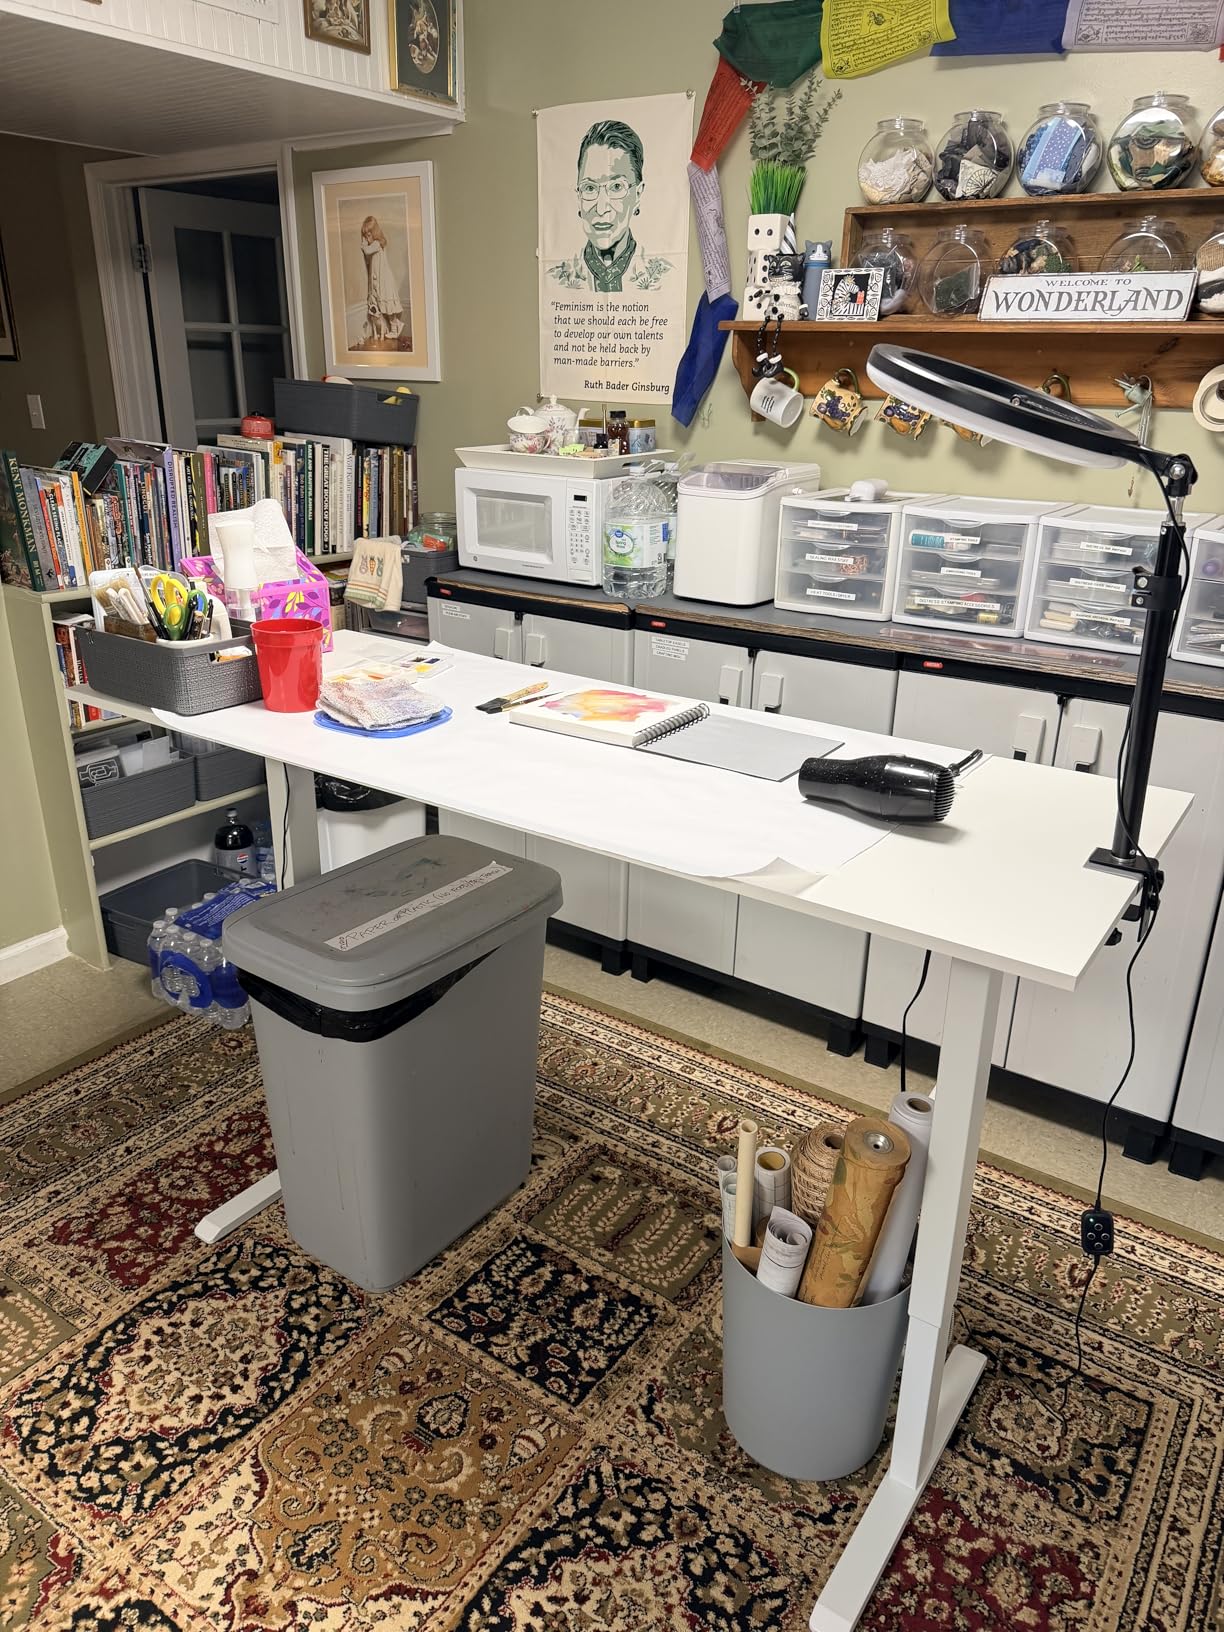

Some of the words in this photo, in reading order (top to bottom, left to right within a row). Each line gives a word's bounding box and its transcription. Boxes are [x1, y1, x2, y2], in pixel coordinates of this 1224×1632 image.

[1045, 278, 1108, 287] WELCOME
[597, 302, 604, 312] is
[606, 302, 620, 312] the
[622, 302, 649, 312] notion
[993, 286, 1184, 316] WONDERLAND
[554, 315, 571, 325] that
[588, 316, 615, 326] should
[617, 316, 636, 326] each
[639, 316, 649, 326] be
[650, 316, 668, 328] free
[564, 329, 595, 341] develop
[634, 330, 664, 340] talents
[554, 342, 569, 352] and
[571, 343, 585, 352] not
[588, 343, 597, 353] be
[599, 343, 616, 353] held
[619, 344, 639, 354] back
[641, 344, 651, 357] by
[554, 356, 598, 366] man-made
[584, 380, 603, 390] Ruth
[606, 381, 629, 391] Bader
[632, 382, 670, 394] Ginsburg
[168, 461, 176, 498] DISRUPTED
[8, 458, 22, 489] KENT
[16, 492, 36, 552] MONKMAN
[324, 512, 329, 520] OF
